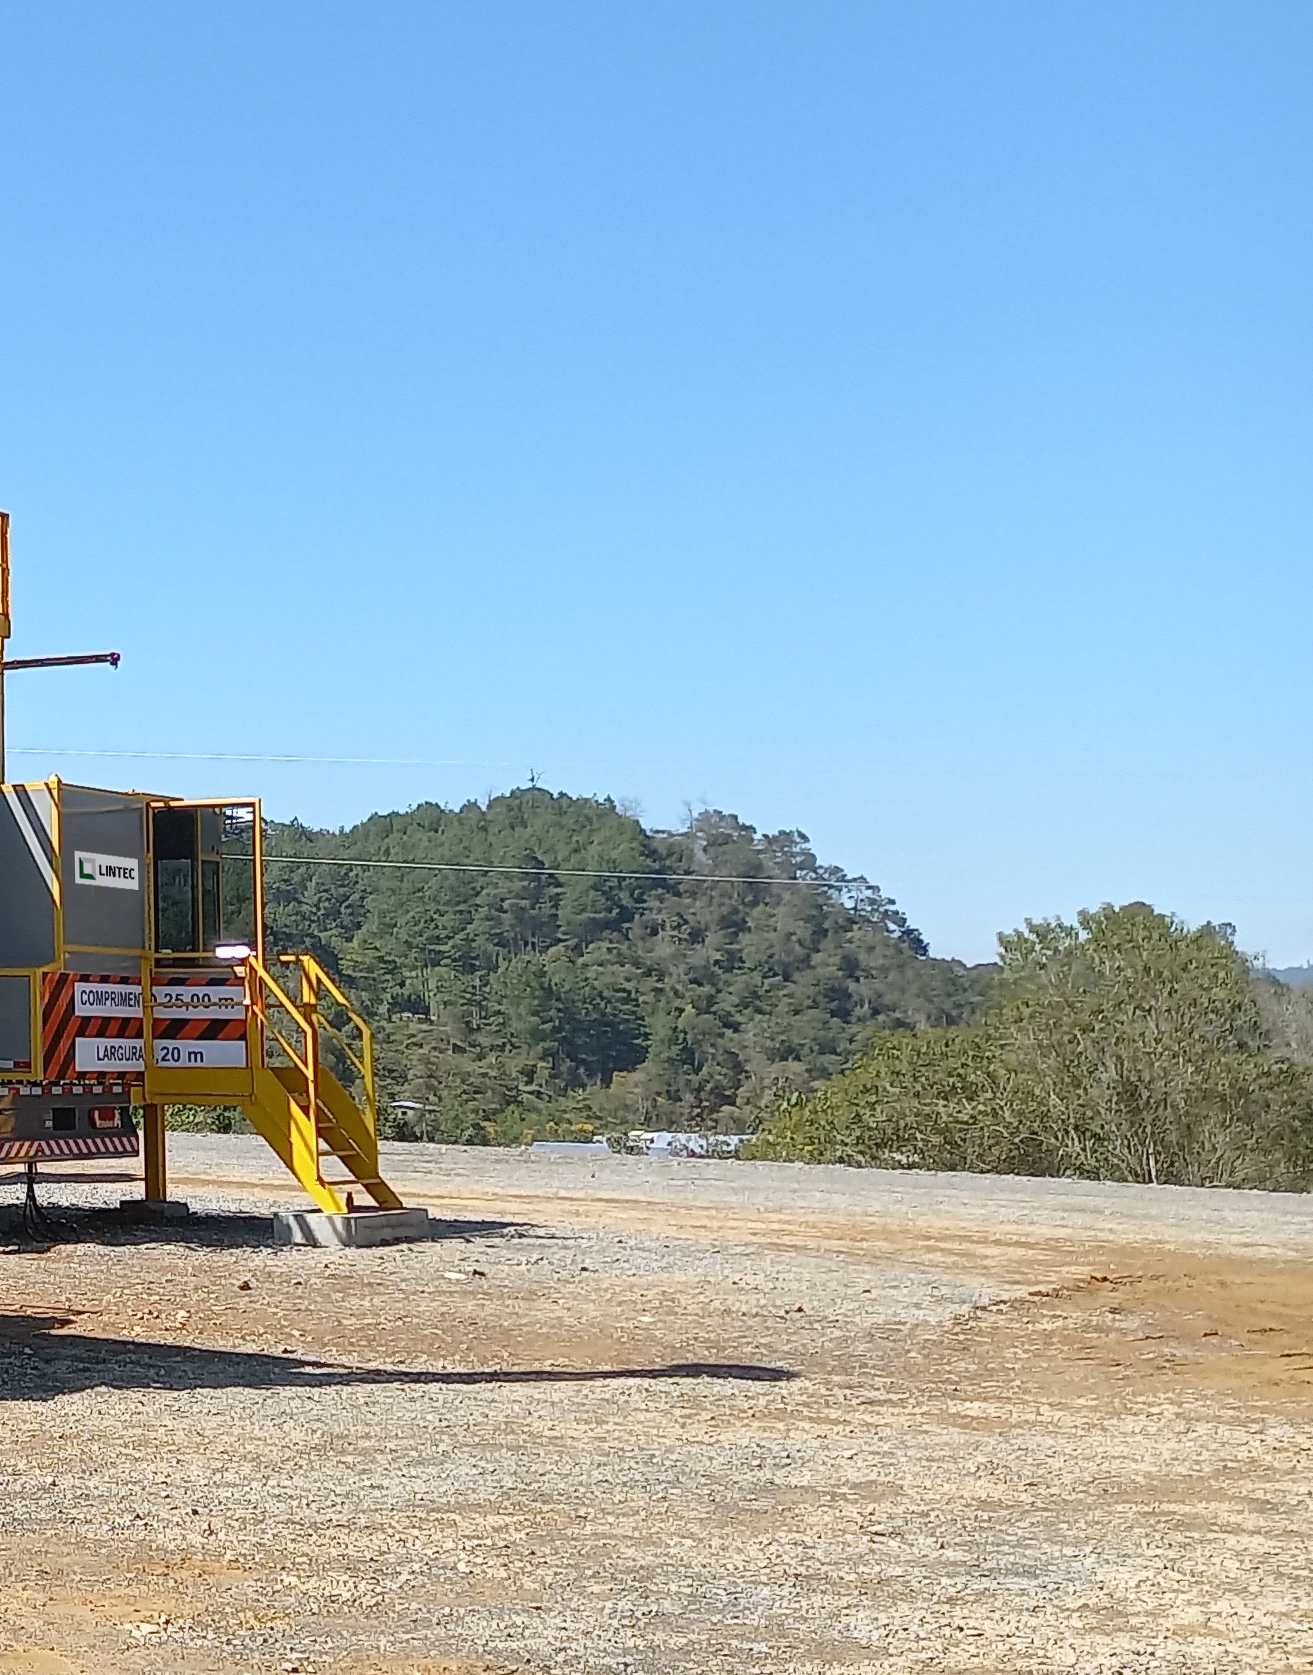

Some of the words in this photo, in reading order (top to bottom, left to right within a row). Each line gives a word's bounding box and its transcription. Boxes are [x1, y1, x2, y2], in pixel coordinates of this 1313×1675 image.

[98, 864, 135, 880] LINTEC
[96, 1044, 146, 1061] LARGURA
[187, 1050, 204, 1063] m
